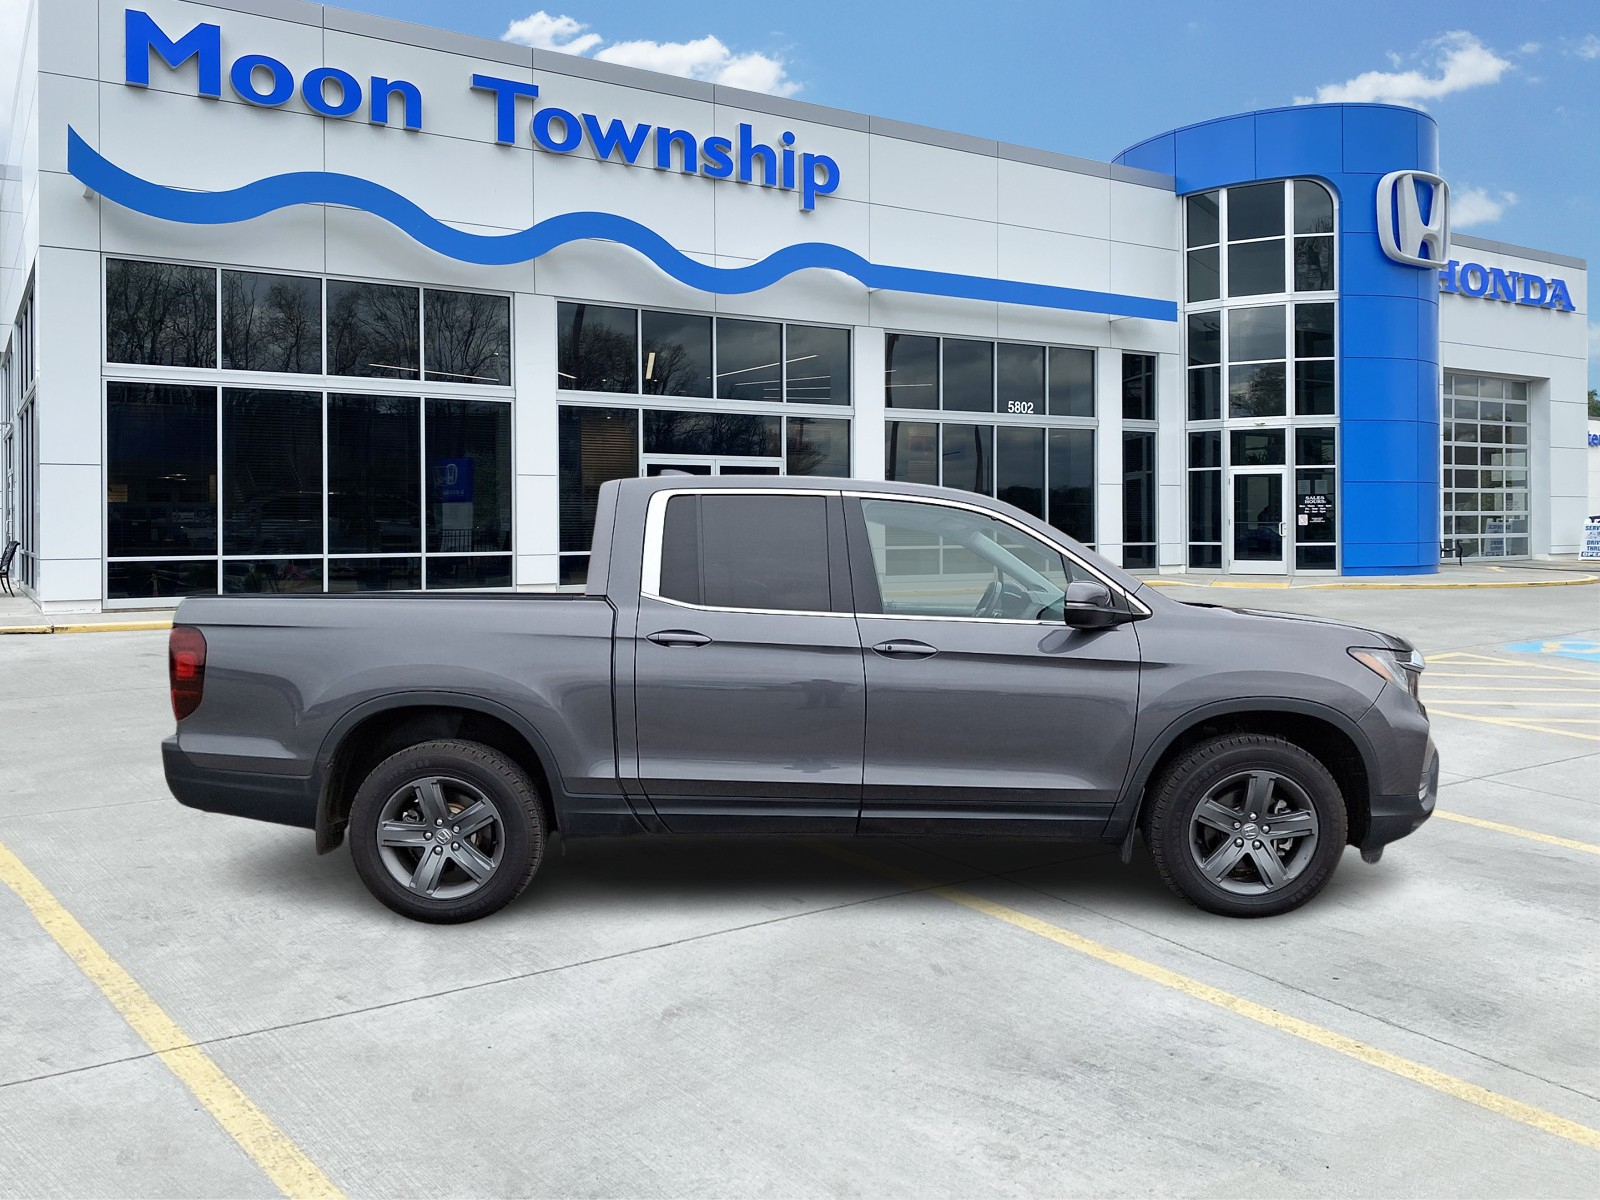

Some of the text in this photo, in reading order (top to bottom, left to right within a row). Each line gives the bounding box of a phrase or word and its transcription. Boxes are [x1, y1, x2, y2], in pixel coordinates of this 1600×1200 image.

[125, 9, 840, 212] Moon Township
[1439, 260, 1576, 312] HONDA
[1008, 401, 1034, 414] 5802
